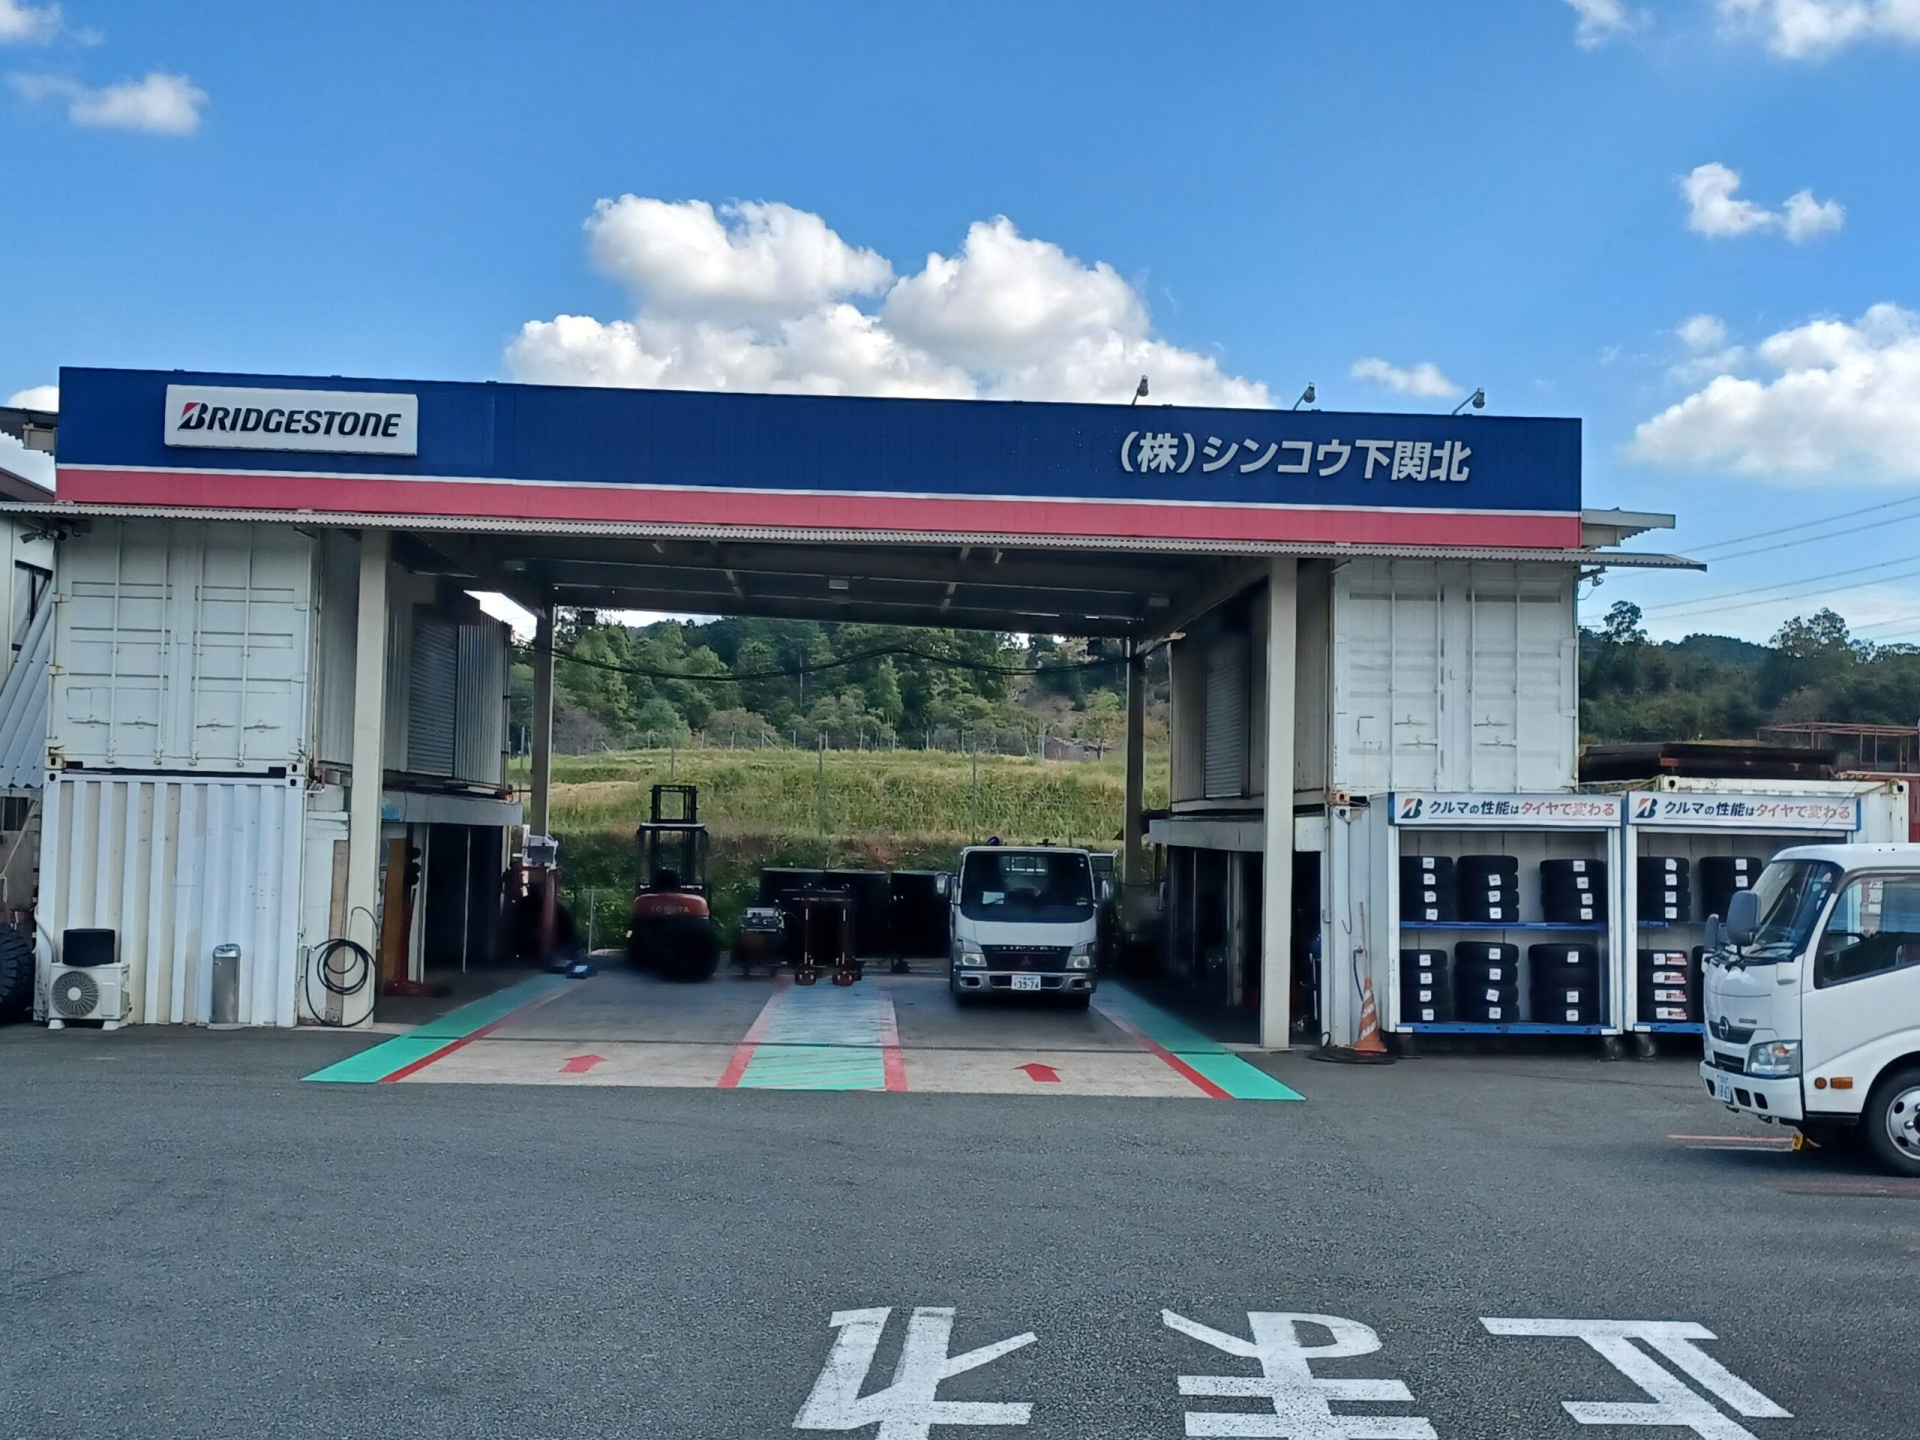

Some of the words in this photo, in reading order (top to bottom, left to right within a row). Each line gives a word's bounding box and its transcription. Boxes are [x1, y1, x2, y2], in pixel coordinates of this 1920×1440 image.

[177, 401, 402, 438] BRIDGESTONE
[1120, 430, 1472, 482] (株)シンコウ下関北
[1429, 800, 1615, 817] クルマの性能はタイヤで変わる
[1664, 800, 1851, 820] クルマの性能はタイヤで変わる
